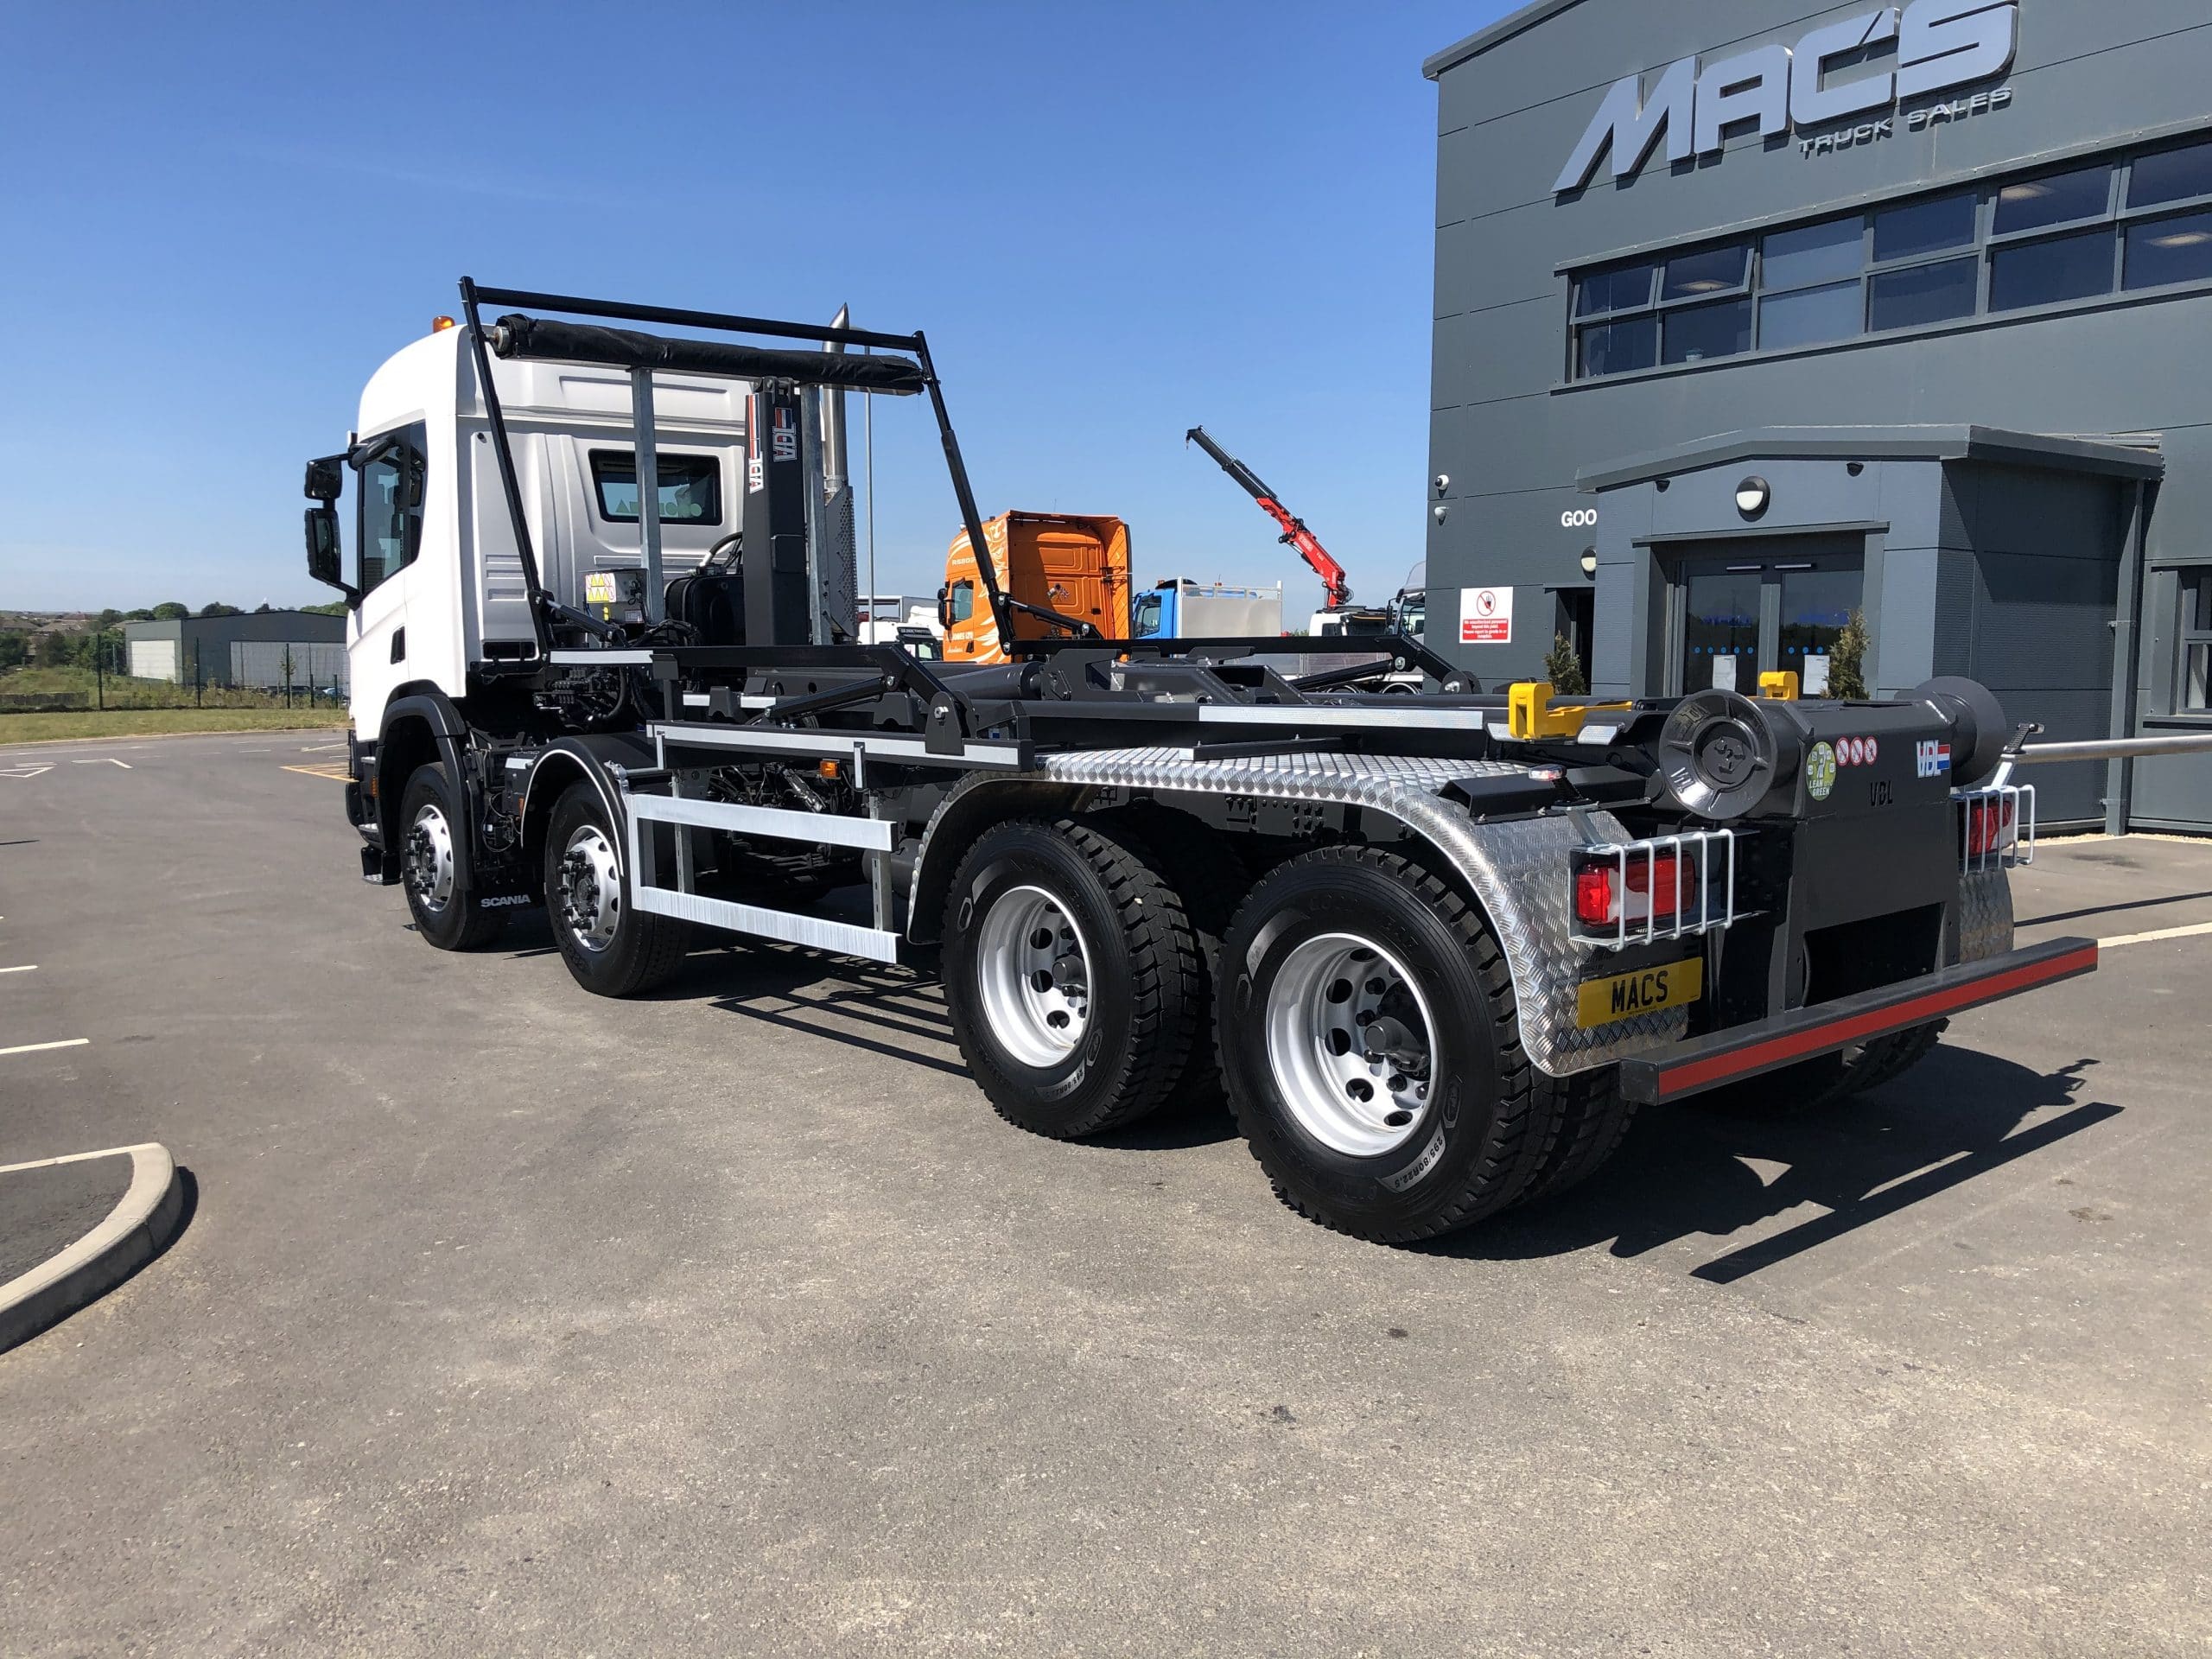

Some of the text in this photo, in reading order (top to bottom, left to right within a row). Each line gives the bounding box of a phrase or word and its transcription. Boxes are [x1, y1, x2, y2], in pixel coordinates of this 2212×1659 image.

[1798, 86, 2012, 153] TRUCK SALES
[772, 423, 797, 462] VDL
[1561, 508, 1598, 527] GOO
[1916, 740, 1941, 778] VDL
[1812, 786, 1830, 797] GREEN
[1871, 780, 1893, 807] VDL
[480, 894, 531, 907] SCANIA
[1611, 969, 1669, 1014] MACS
[1395, 1135, 1443, 1189] 295/80R22.5
